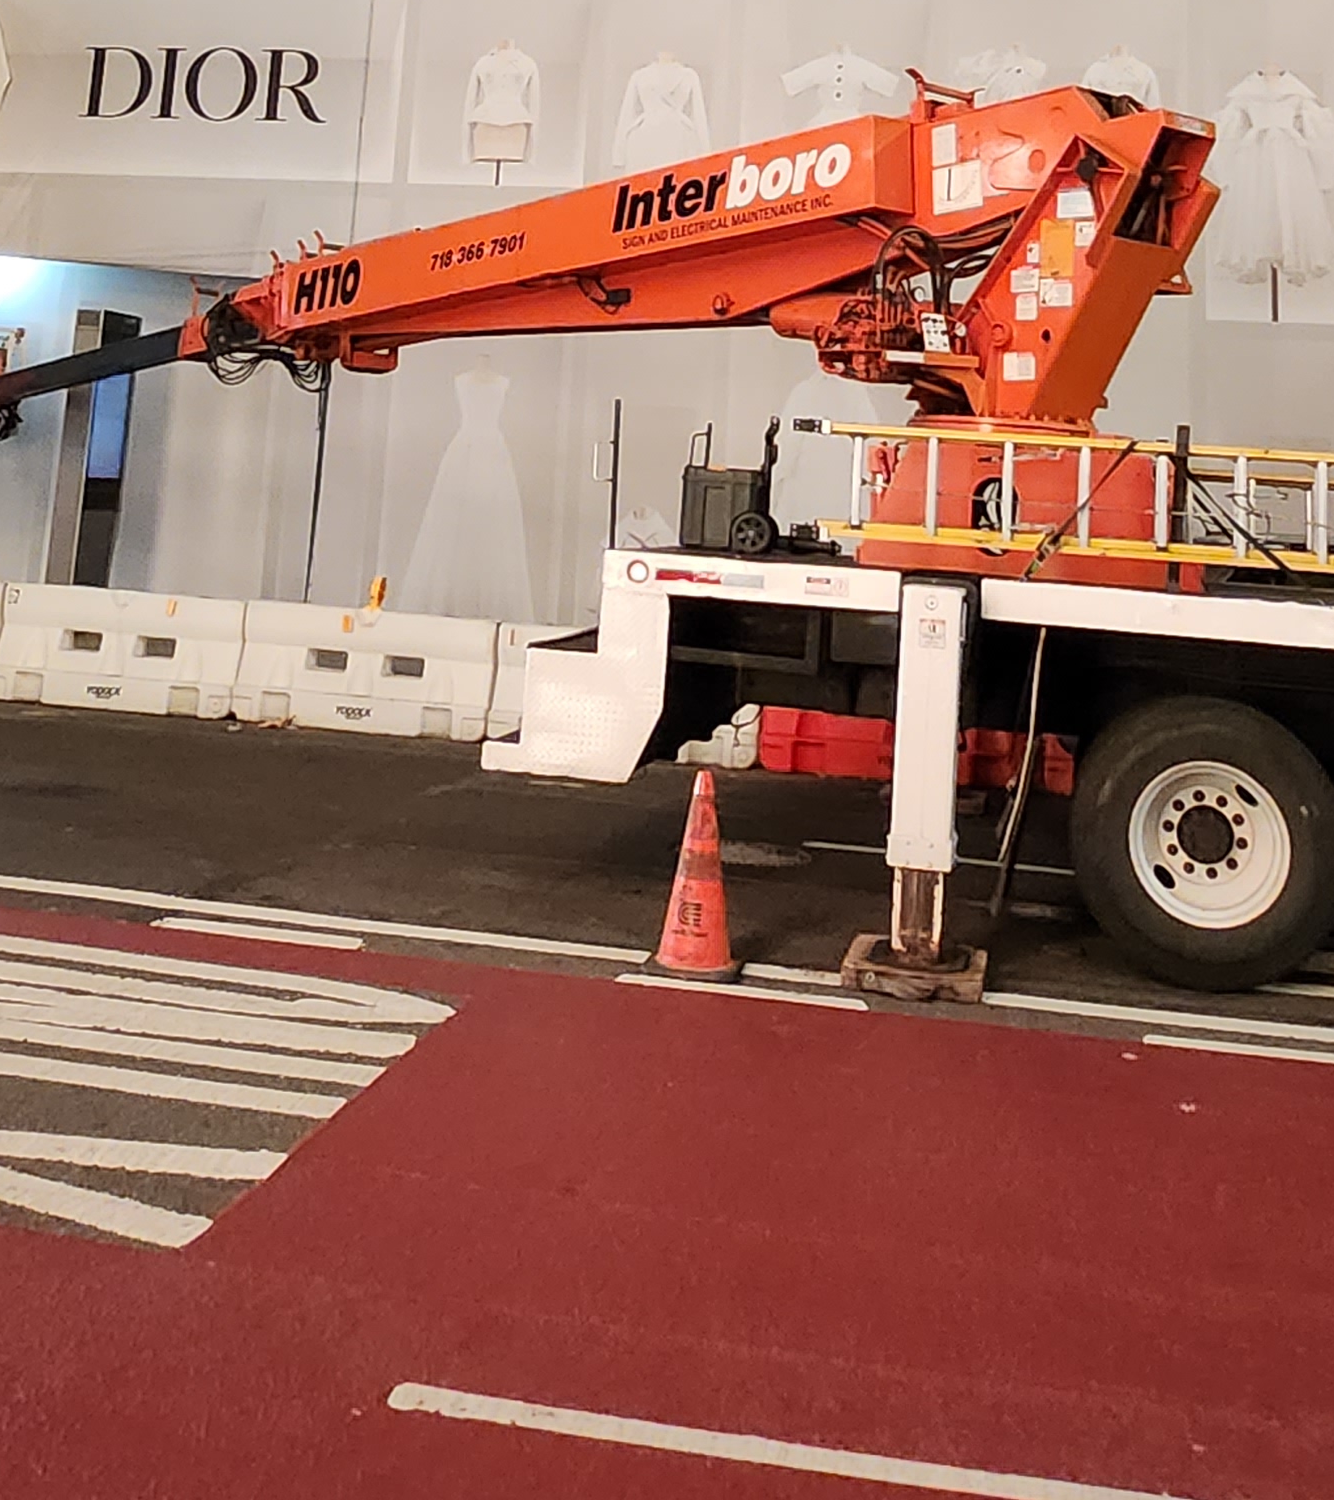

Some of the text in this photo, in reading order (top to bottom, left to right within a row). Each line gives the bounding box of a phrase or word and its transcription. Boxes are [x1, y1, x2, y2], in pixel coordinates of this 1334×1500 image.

[78, 46, 327, 123] DIOR
[612, 142, 852, 233] Interboro
[622, 194, 834, 250] SIGN AND ELECTRICAL MAINTENANCE INC.
[430, 231, 525, 271] 718 366 7901
[294, 259, 361, 315] H110
